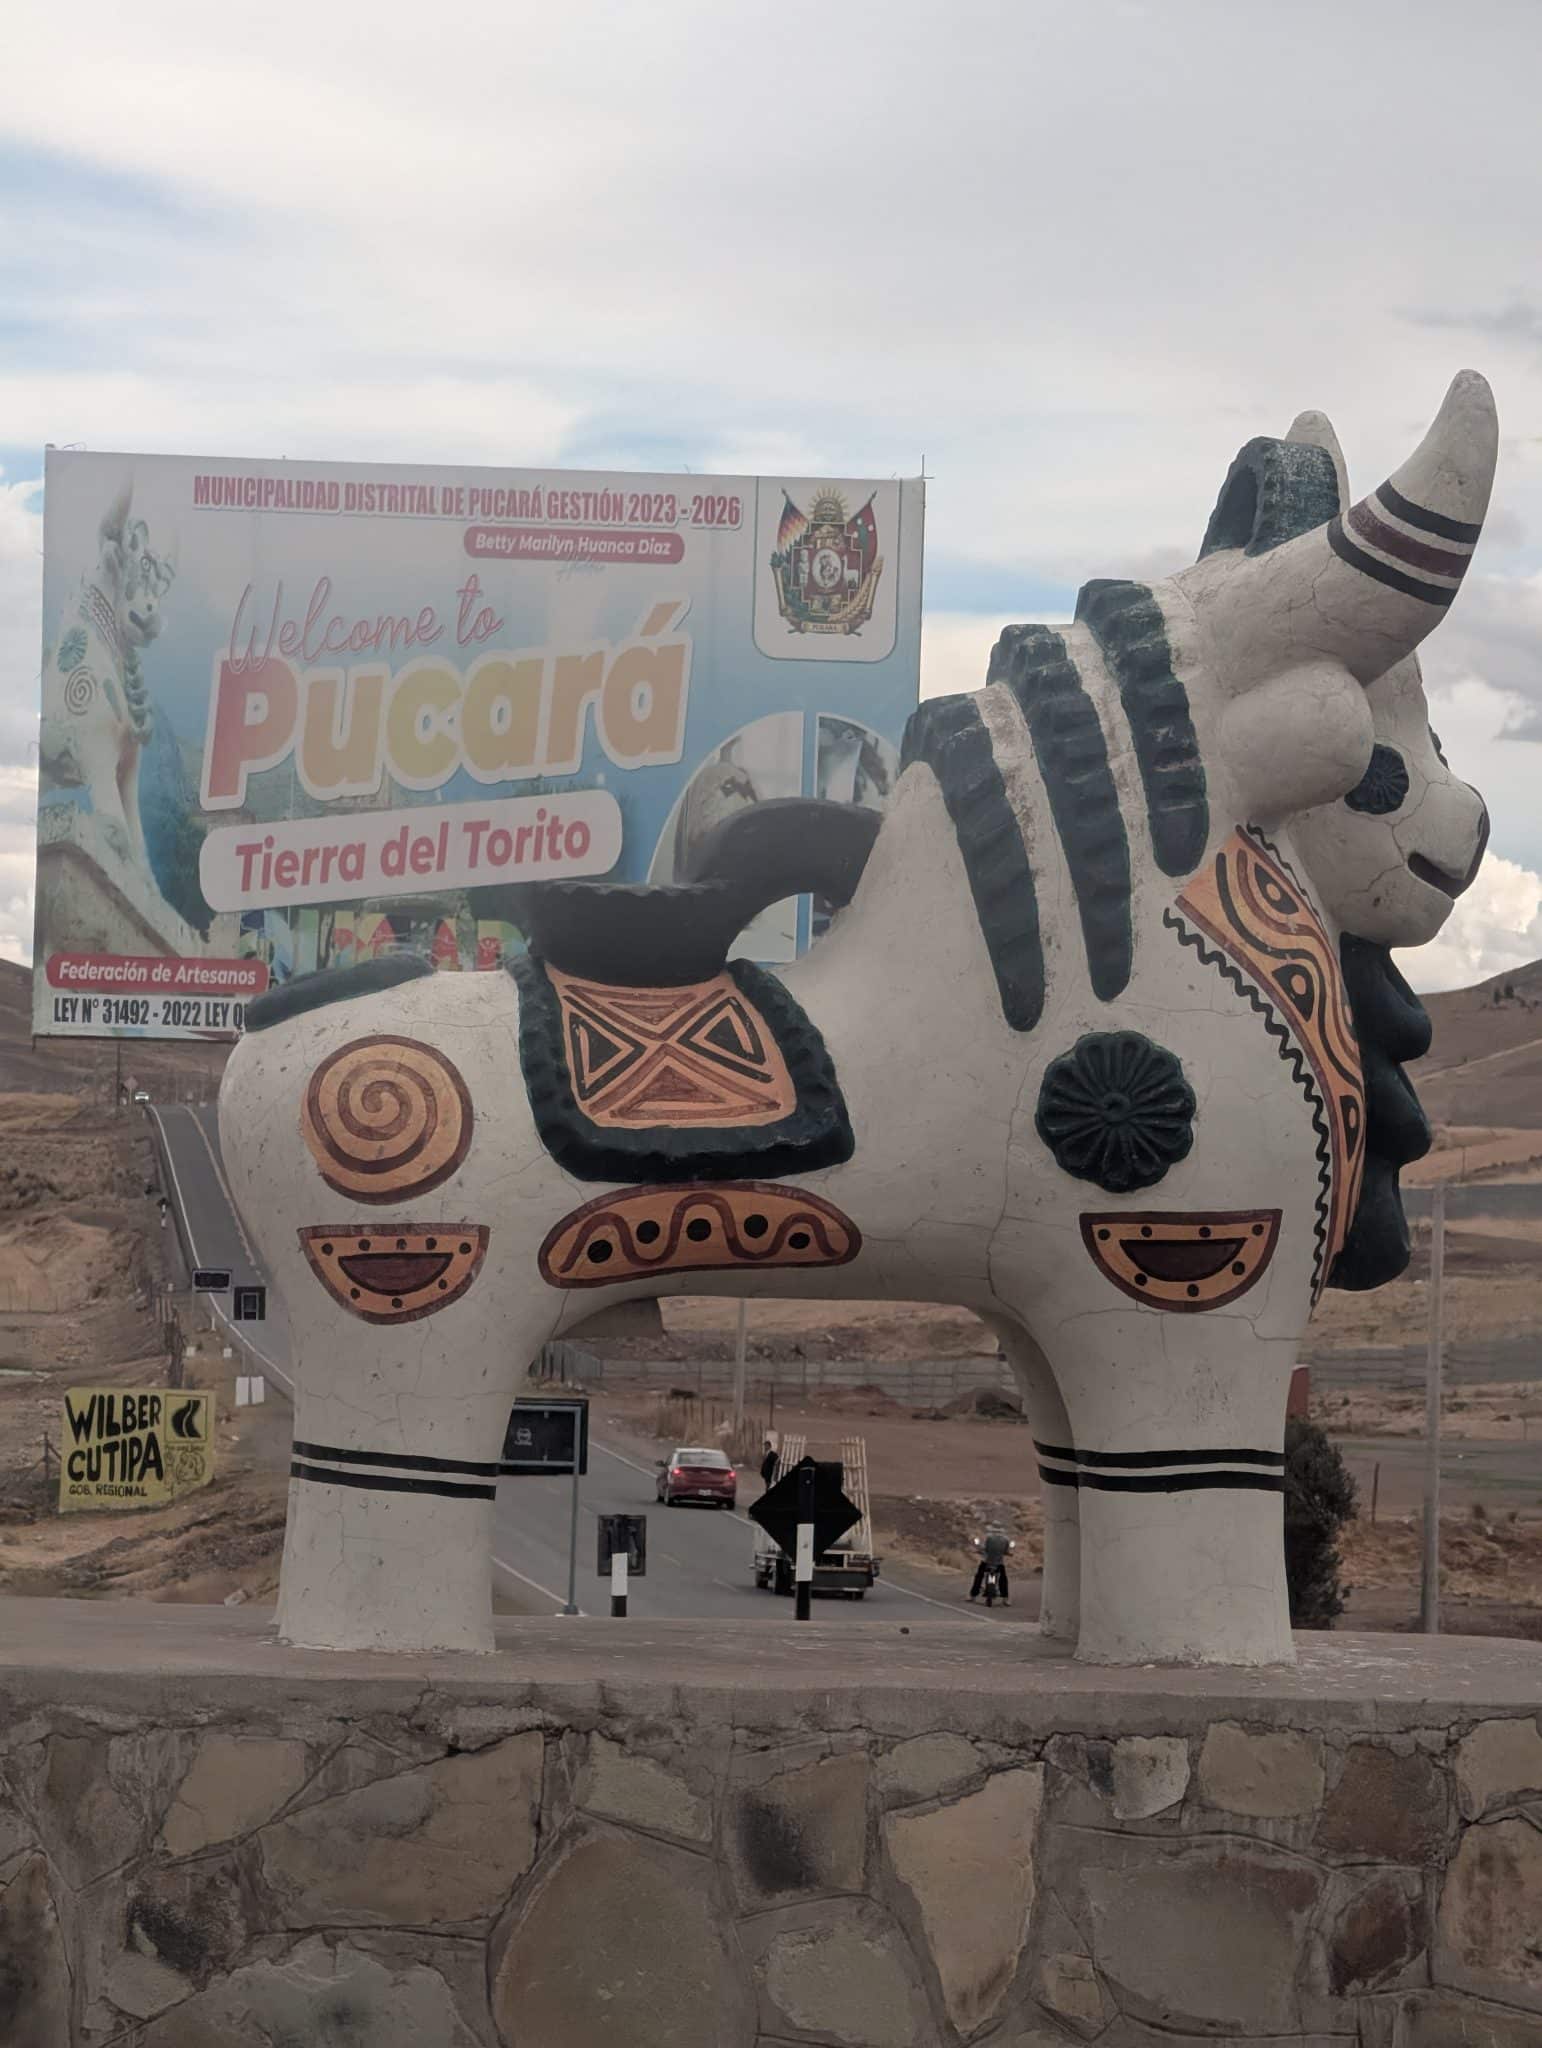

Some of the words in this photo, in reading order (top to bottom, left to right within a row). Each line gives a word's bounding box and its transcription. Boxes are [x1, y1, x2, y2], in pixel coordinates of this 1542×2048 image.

[194, 476, 340, 510] MUNICIPALIDAD
[344, 482, 436, 515] DISTRITAL
[441, 487, 464, 515] DE
[468, 484, 542, 519] PUCARÁ
[547, 488, 624, 521] GESTIÓN
[628, 494, 676, 523] 2023
[692, 495, 741, 525] 2026
[475, 533, 516, 553] Betty
[519, 534, 574, 555] Marilyn
[578, 536, 635, 553] Huanca
[229, 576, 444, 673] Welcome
[456, 574, 504, 648] to
[206, 600, 689, 802] Pucará
[235, 836, 367, 893] Tierra
[380, 825, 450, 877] del
[462, 808, 591, 869] Torito
[59, 961, 148, 983] Federación
[151, 964, 171, 982] de
[174, 966, 257, 986] Artesanos
[54, 997, 79, 1023] LEY
[102, 998, 150, 1025] 31492
[162, 1000, 200, 1028] 2022
[205, 1003, 229, 1028] LEY
[65, 1394, 162, 1445] WILBER
[67, 1431, 164, 1482] CUTIPA
[95, 1484, 148, 1497] REGIONAL
